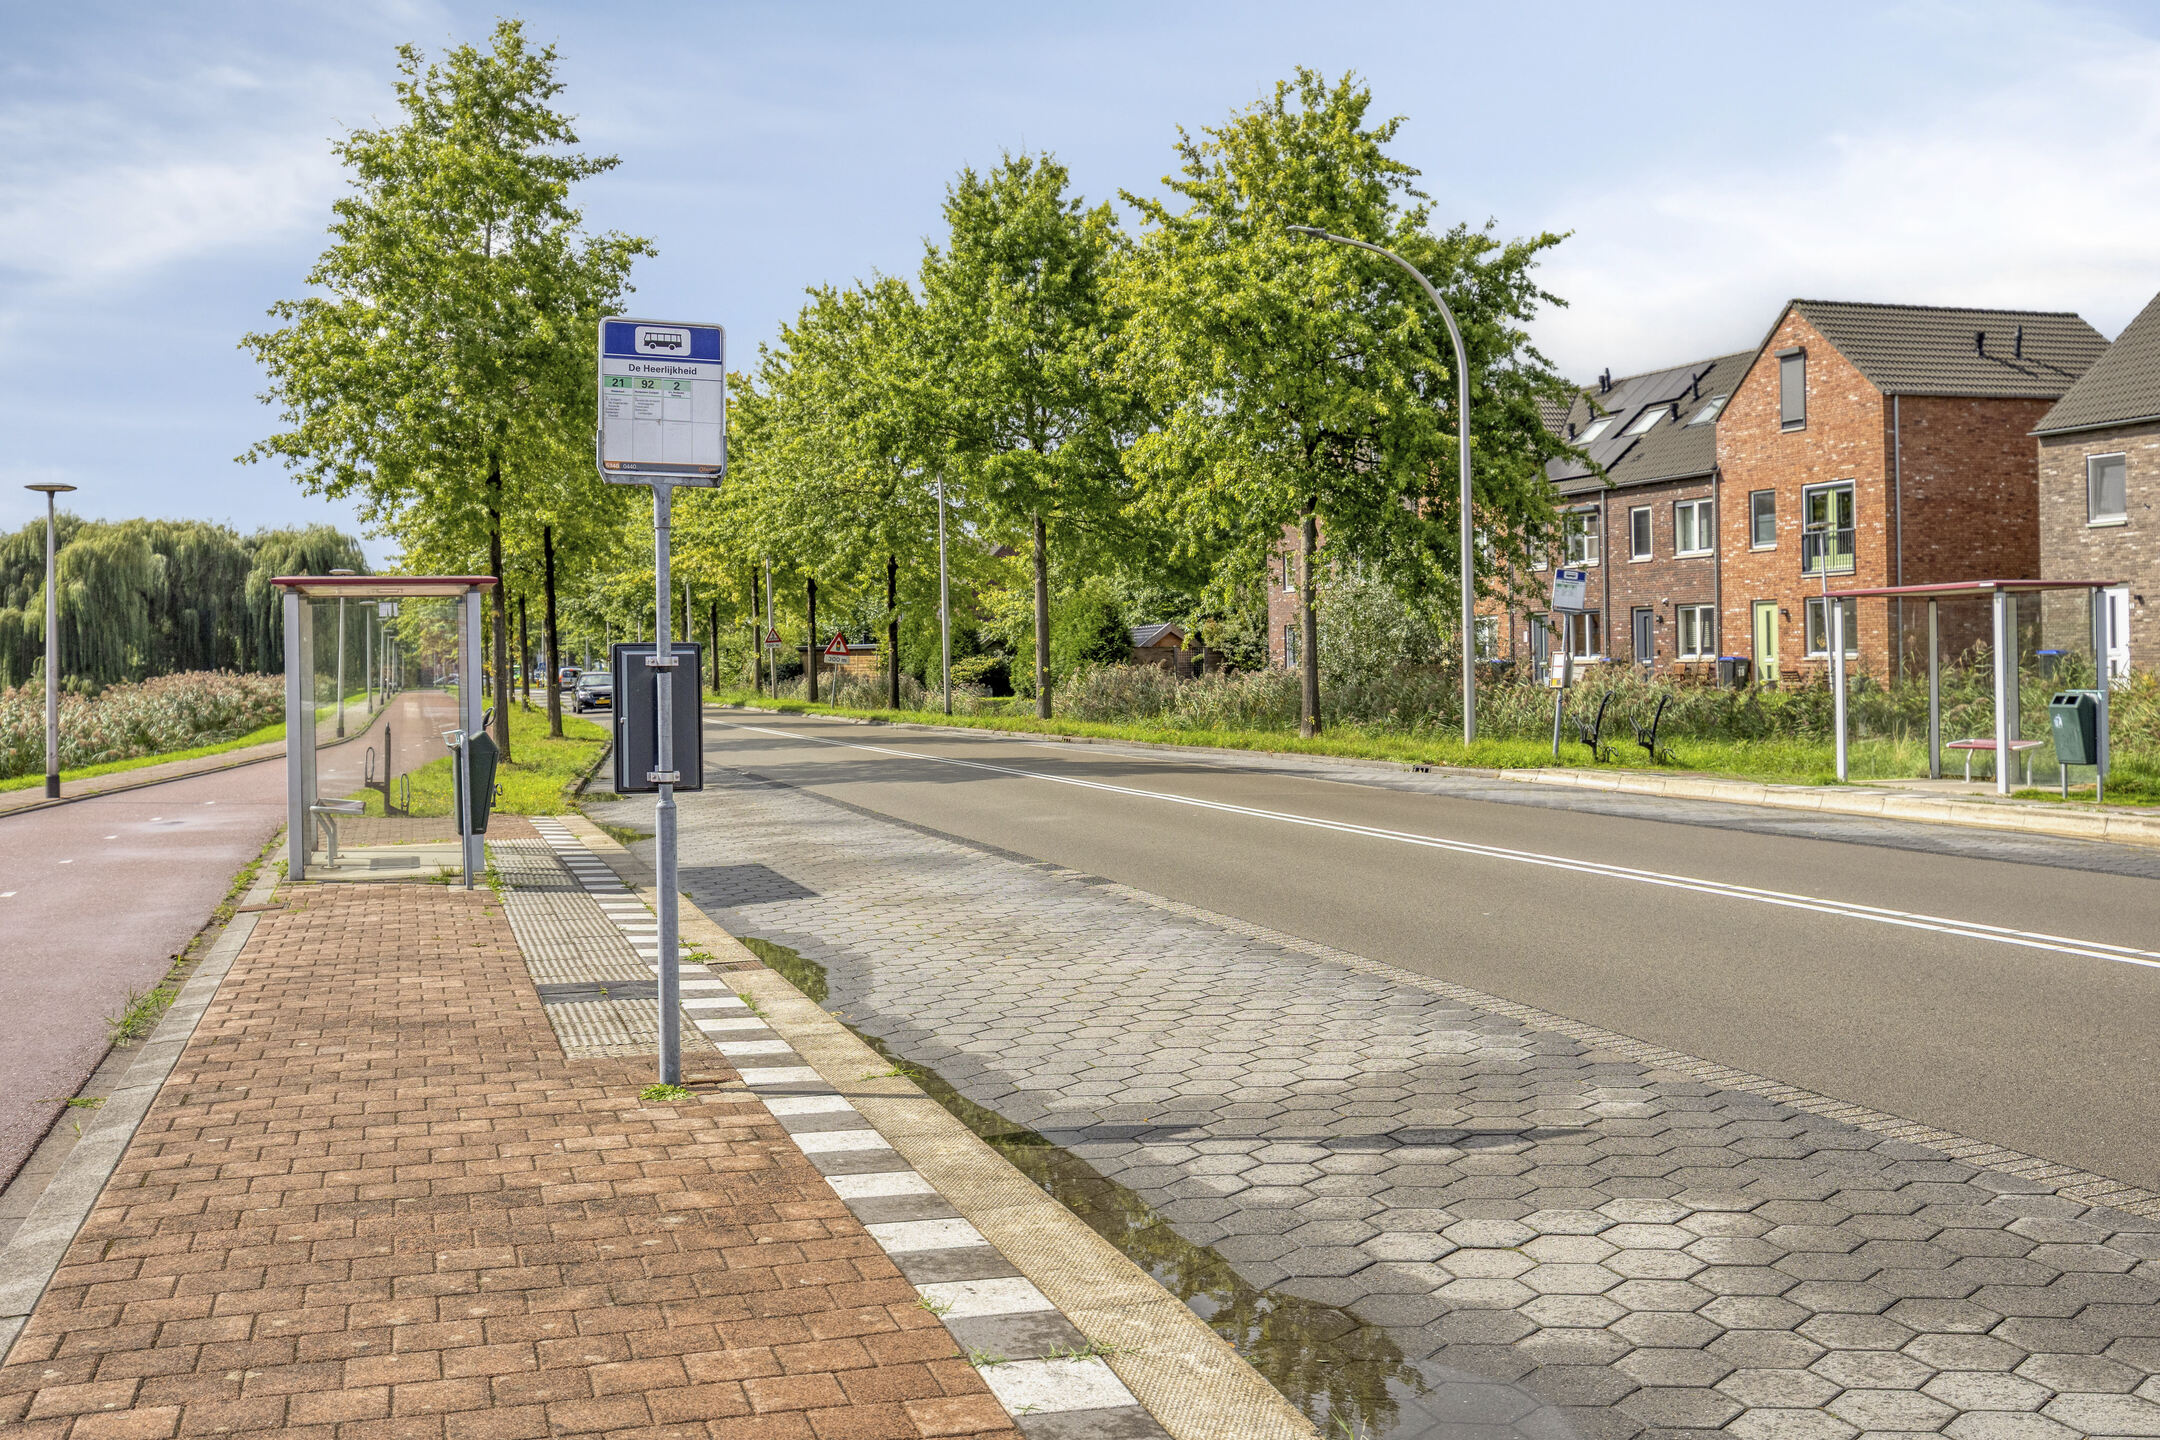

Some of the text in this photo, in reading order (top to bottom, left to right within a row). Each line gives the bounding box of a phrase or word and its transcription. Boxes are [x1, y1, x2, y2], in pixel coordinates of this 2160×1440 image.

[628, 363, 697, 376] De Heerlijkheid
[612, 378, 625, 387] 21
[641, 380, 655, 389] 92
[673, 382, 681, 391] 2
